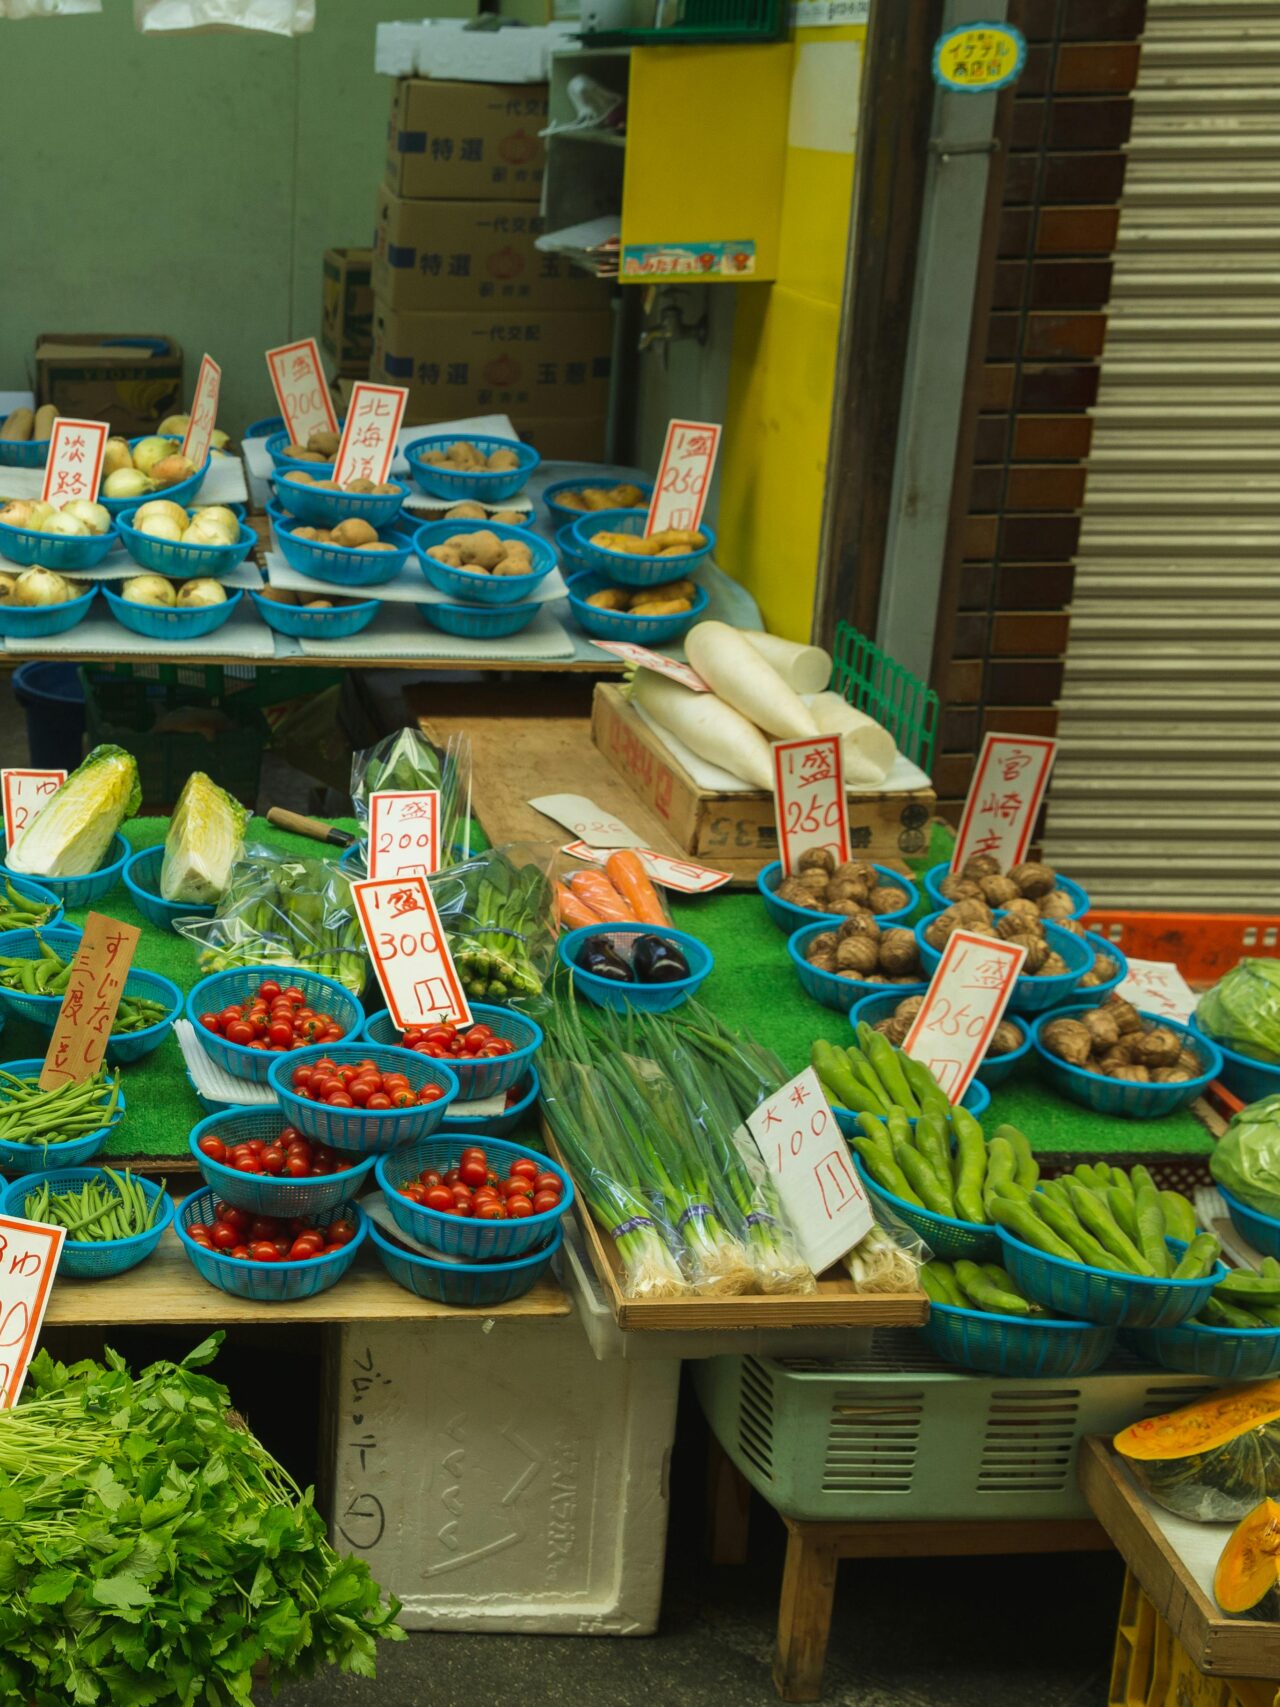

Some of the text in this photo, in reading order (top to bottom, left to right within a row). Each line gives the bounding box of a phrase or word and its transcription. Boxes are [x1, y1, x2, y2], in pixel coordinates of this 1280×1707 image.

[431, 137, 483, 161] 特選
[420, 254, 471, 278] 特選
[472, 325, 541, 341] 一代交配
[419, 362, 469, 386] 特選
[342, 397, 391, 486] 北海道
[52, 435, 87, 512] 淡路
[15, 806, 41, 830] 2
[377, 833, 429, 854] 200
[376, 931, 439, 961] 300
[84, 932, 129, 1064] すじなし
[926, 998, 987, 1038] 250
[777, 1110, 827, 1173] 100
